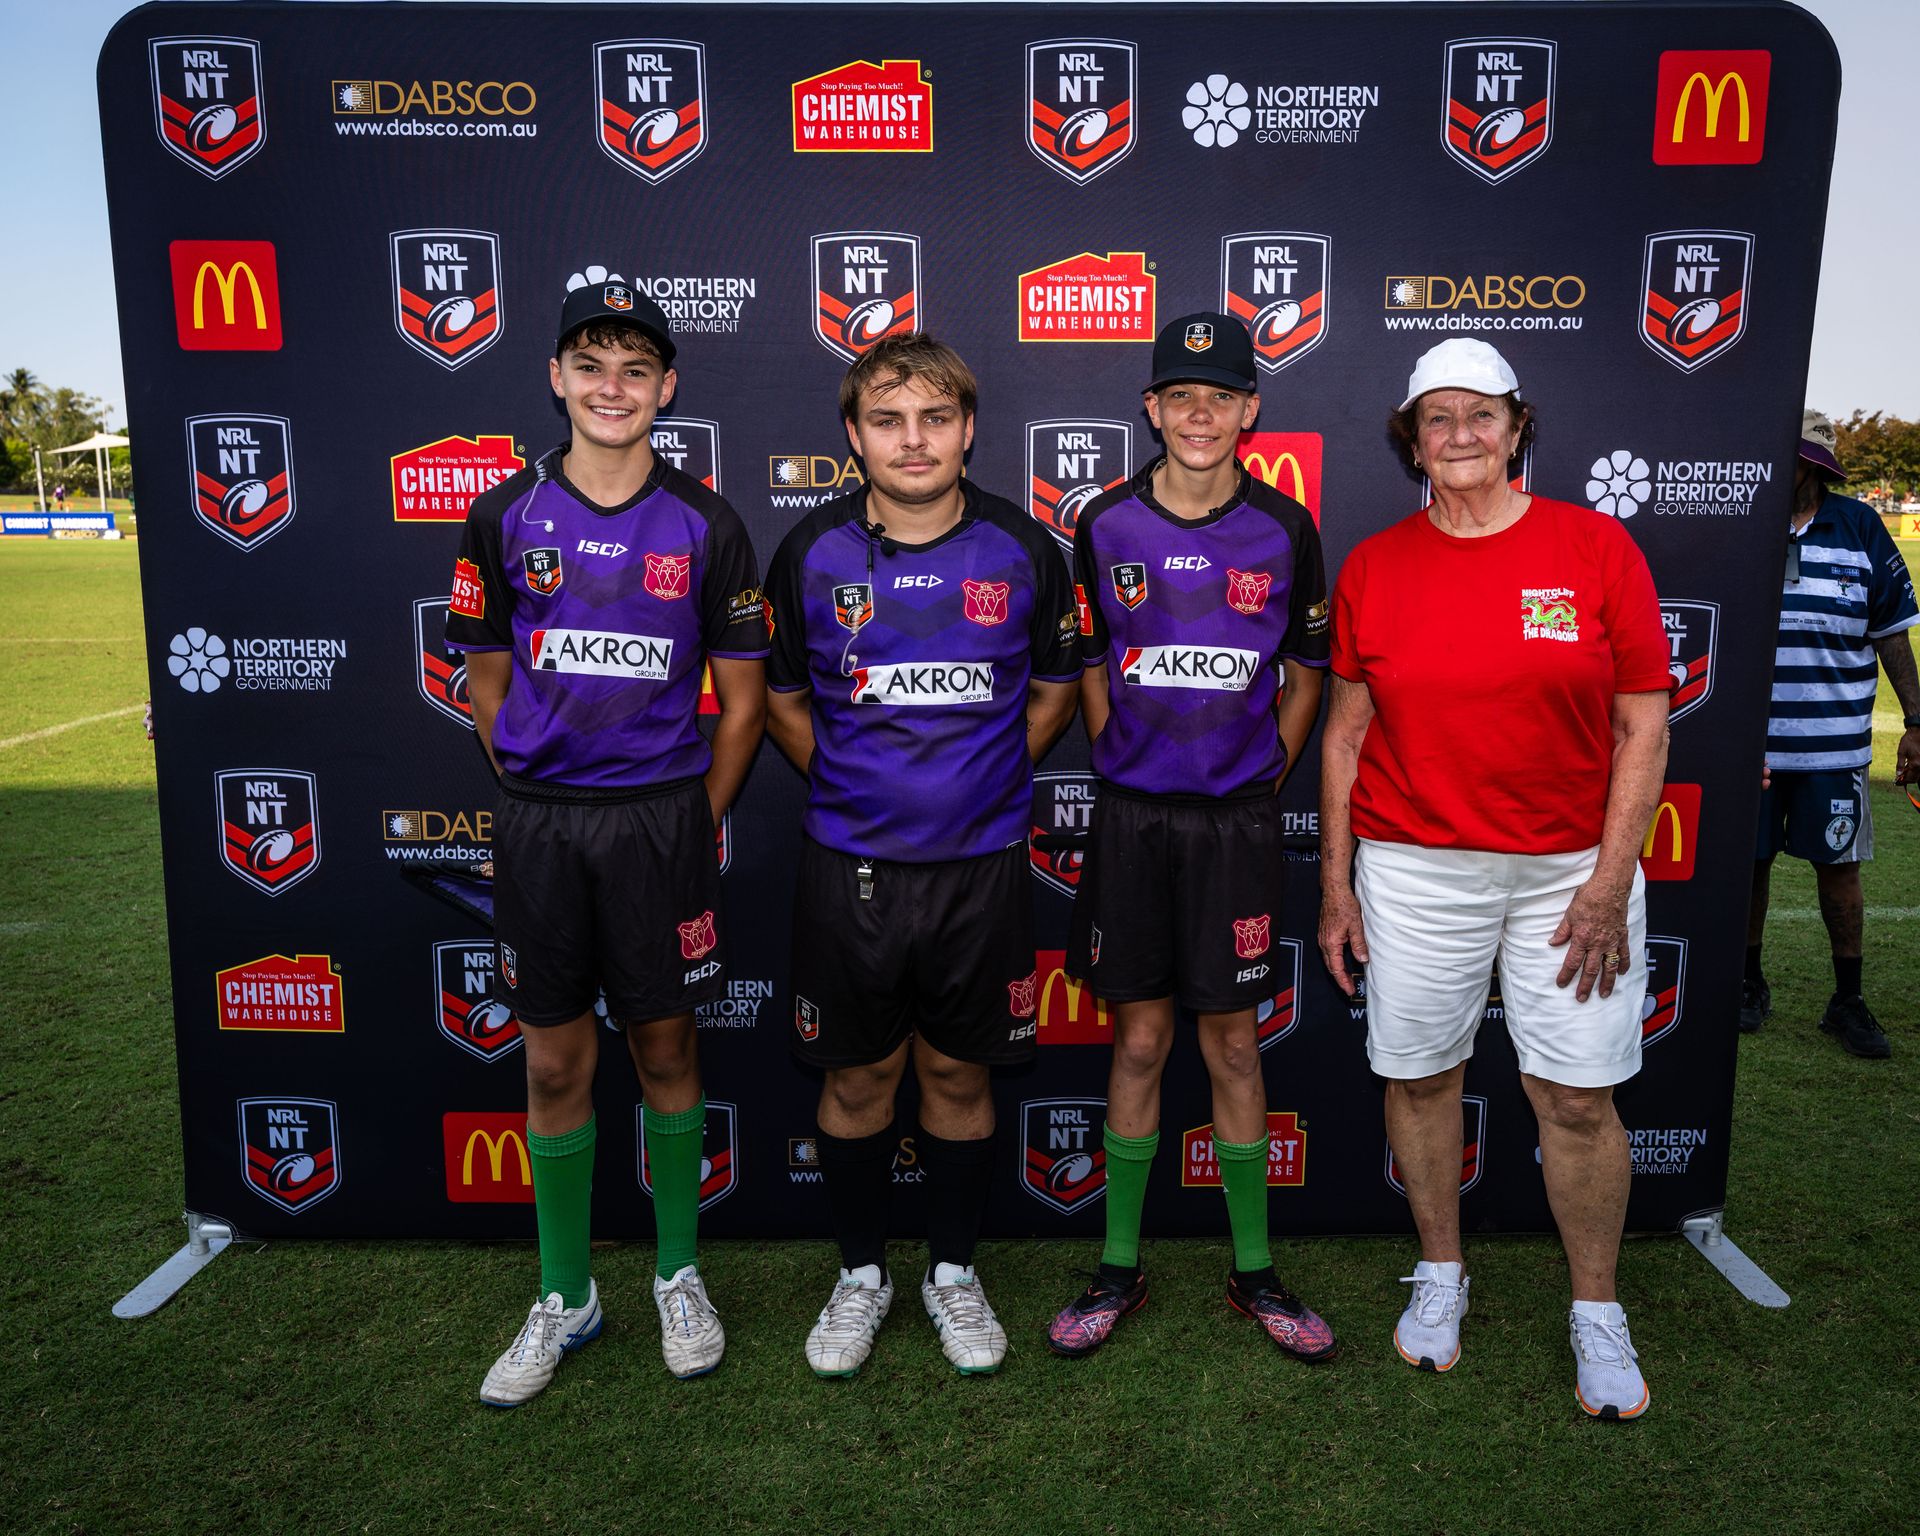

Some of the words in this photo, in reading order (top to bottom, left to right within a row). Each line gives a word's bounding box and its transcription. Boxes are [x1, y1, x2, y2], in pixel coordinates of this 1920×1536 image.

[183, 50, 228, 69] NRL
[627, 54, 672, 72] NRL
[1059, 54, 1104, 72] NRL
[1477, 52, 1522, 71] NRL
[184, 72, 229, 98] NT
[628, 76, 672, 103] NT
[839, 83, 862, 91] Paying
[1060, 76, 1104, 103] NT
[1476, 75, 1522, 102] NT
[373, 81, 537, 116] DABSCO
[1256, 86, 1379, 107] NORTHERN
[802, 94, 923, 121] CHEMIST
[335, 118, 537, 137] www.dabsco.com.au
[1255, 109, 1366, 129] TERRITORY
[803, 126, 920, 139] WAREHOUSE
[1255, 130, 1360, 144] GOVERNMENT
[423, 243, 467, 262] NRL
[844, 246, 888, 264] NRL
[1254, 246, 1298, 264] NRL
[1676, 245, 1720, 263] NRL
[425, 265, 468, 291] NT
[844, 268, 888, 294] NT
[1047, 274, 1063, 282] Stop
[1064, 274, 1088, 283] Paying
[1089, 274, 1102, 282] Too
[1103, 274, 1128, 282] Much!!
[1253, 268, 1297, 294] NT
[1674, 266, 1720, 293] NT
[636, 278, 756, 298] NORTHERN
[1427, 275, 1586, 310] DABSCO
[1028, 285, 1147, 312] CHEMIST
[652, 300, 743, 319] RRITORY
[668, 320, 740, 333] ERNMENT
[1028, 316, 1142, 330] WAREHOUSE
[1385, 313, 1582, 331] www.dabsco.com.au
[217, 428, 259, 446] NRL
[1058, 433, 1101, 450] NRL
[218, 449, 261, 475] NT
[418, 456, 434, 464] Stop
[435, 456, 458, 465] Paying
[1058, 454, 1101, 478] NT
[1658, 461, 1772, 482] NORTHERN
[1655, 483, 1759, 502] TERRITORY
[402, 497, 475, 510] WAREH
[1654, 502, 1752, 516] GOVERNMENT
[532, 552, 549, 560] NRL
[577, 540, 614, 556] ISC
[534, 560, 549, 571] NT
[1164, 557, 1198, 570] ISC
[894, 576, 929, 589] ISC
[1121, 574, 1135, 584] NT
[844, 595, 861, 605] NT
[1521, 588, 1575, 598] NIGHTCLIFF
[1661, 613, 1688, 629] RL
[1523, 627, 1539, 640] THE
[1540, 627, 1579, 642] DRAGONS
[234, 639, 347, 658] NORTHERN
[559, 633, 671, 670] AKRON
[1667, 633, 1687, 657] T
[234, 659, 336, 678] TERRITORY
[634, 670, 656, 679] GROUP
[1150, 650, 1258, 681] AKRON
[235, 678, 331, 691] GOVERNMENT
[886, 666, 992, 694] AKRON
[961, 694, 981, 702] GROUP
[982, 693, 991, 701] NT
[245, 781, 286, 798] NRL
[1054, 785, 1096, 801] NRL
[246, 801, 287, 825] NT
[1054, 803, 1094, 827] NT
[421, 811, 493, 841] DAB
[242, 972, 257, 980] Stop
[257, 972, 279, 980] Paying
[684, 964, 709, 985] ISC
[1236, 966, 1260, 983] ISC
[225, 981, 334, 1007] CHEMIST
[227, 1008, 332, 1022] WAREHOUSE
[696, 1016, 757, 1028] ERNMENT
[268, 1109, 308, 1125] NRL
[1050, 1110, 1090, 1124] NRL
[269, 1127, 308, 1149] NT
[1050, 1127, 1089, 1149] NT
[1631, 1147, 1694, 1163] RITORY
[1631, 1163, 1688, 1174] ERNMENT
